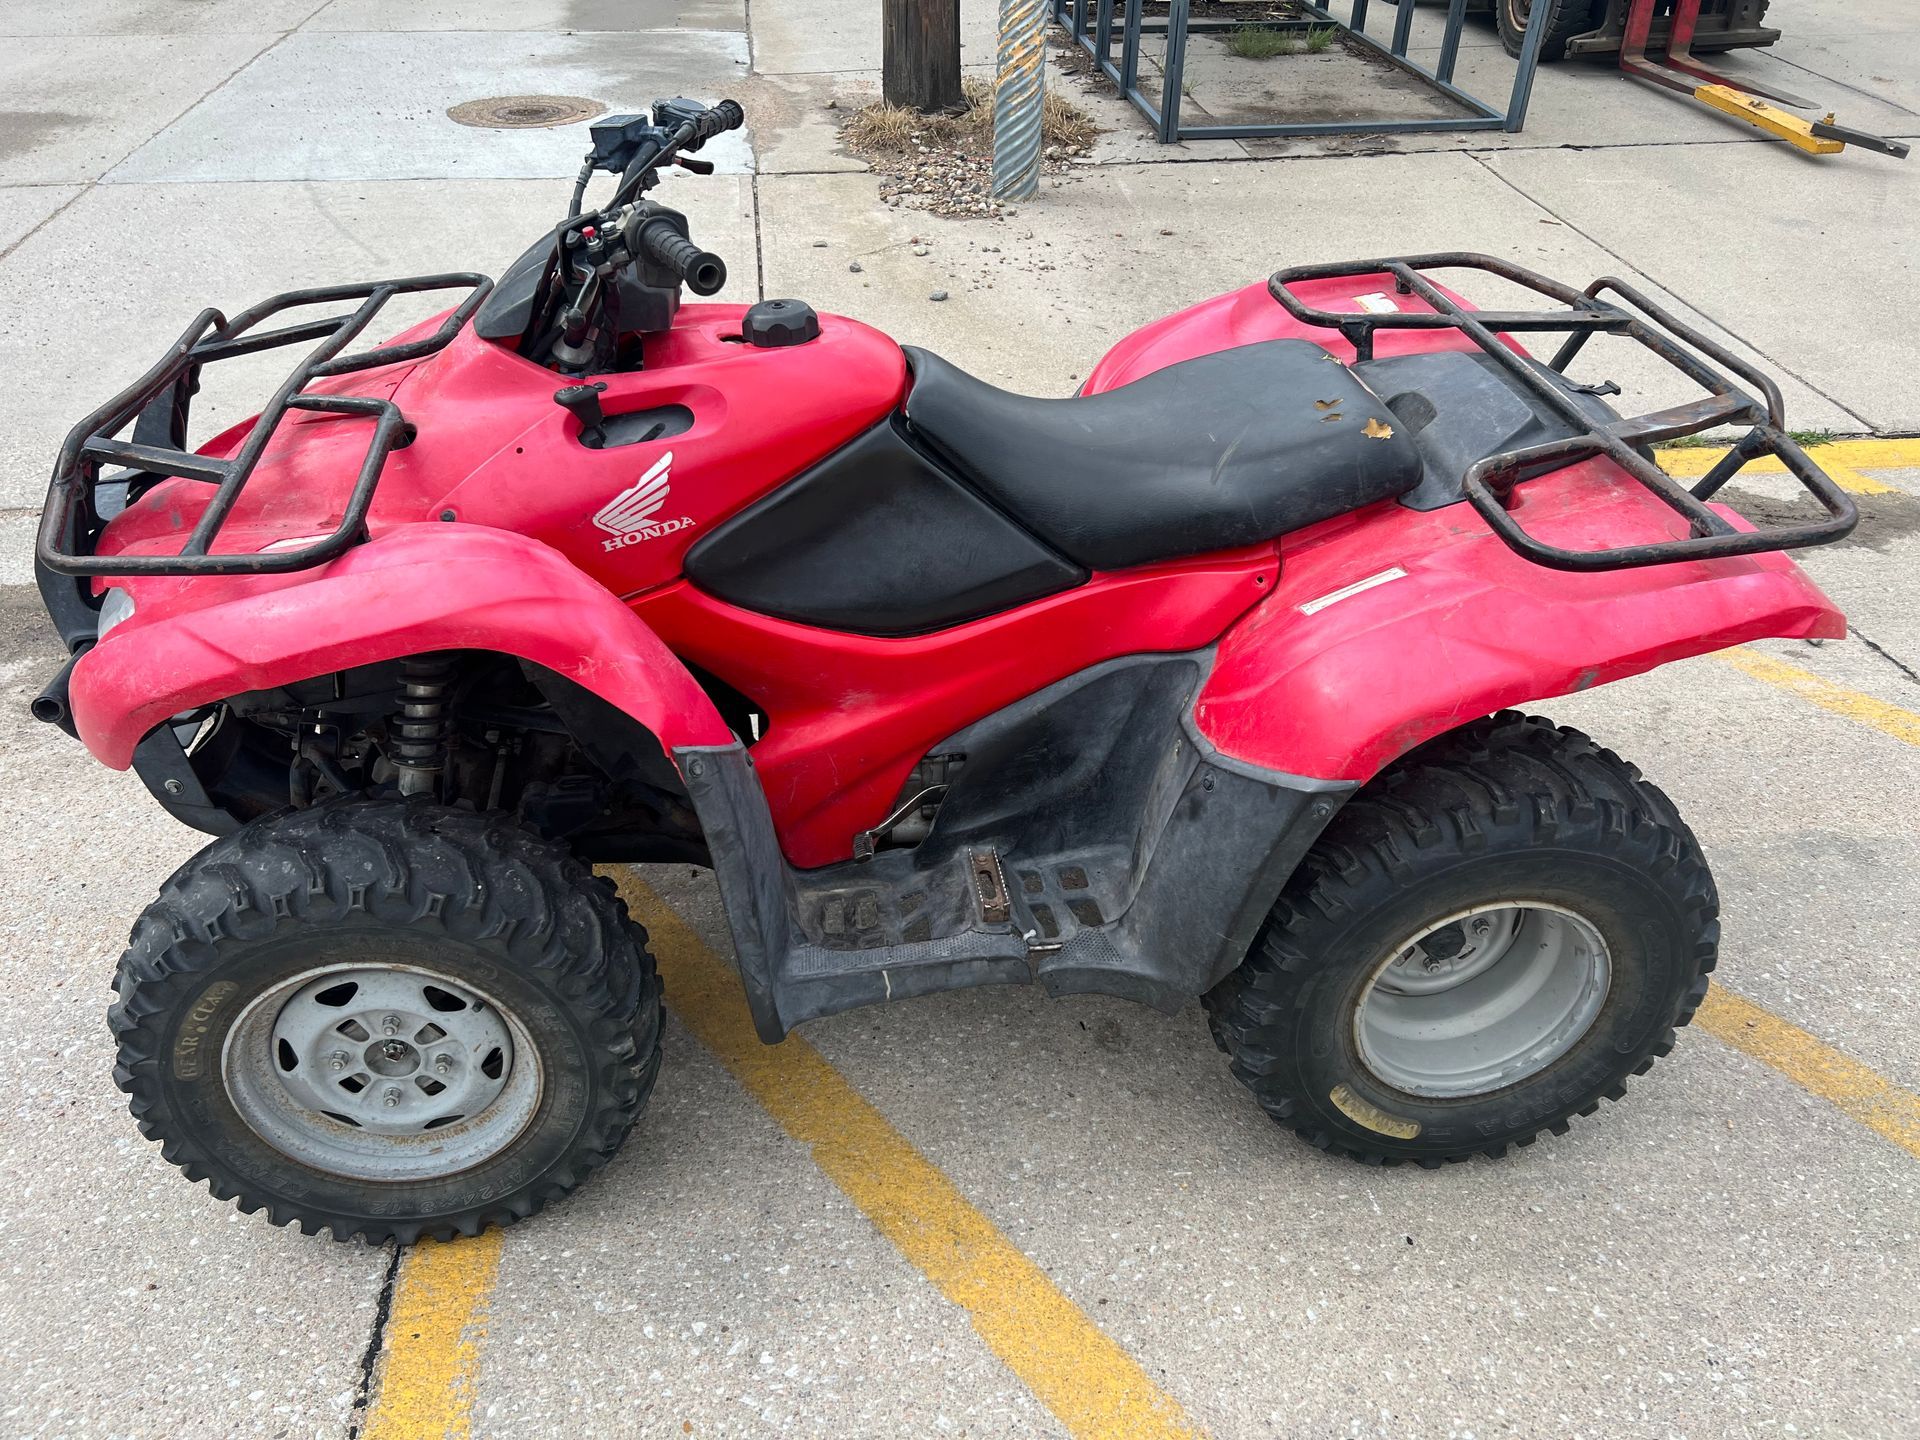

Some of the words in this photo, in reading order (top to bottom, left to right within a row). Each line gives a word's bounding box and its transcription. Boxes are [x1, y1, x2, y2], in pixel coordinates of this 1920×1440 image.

[601, 516, 696, 552] HONDA
[1473, 1063, 1614, 1136] KENDA
[215, 1136, 311, 1200] KENDA
